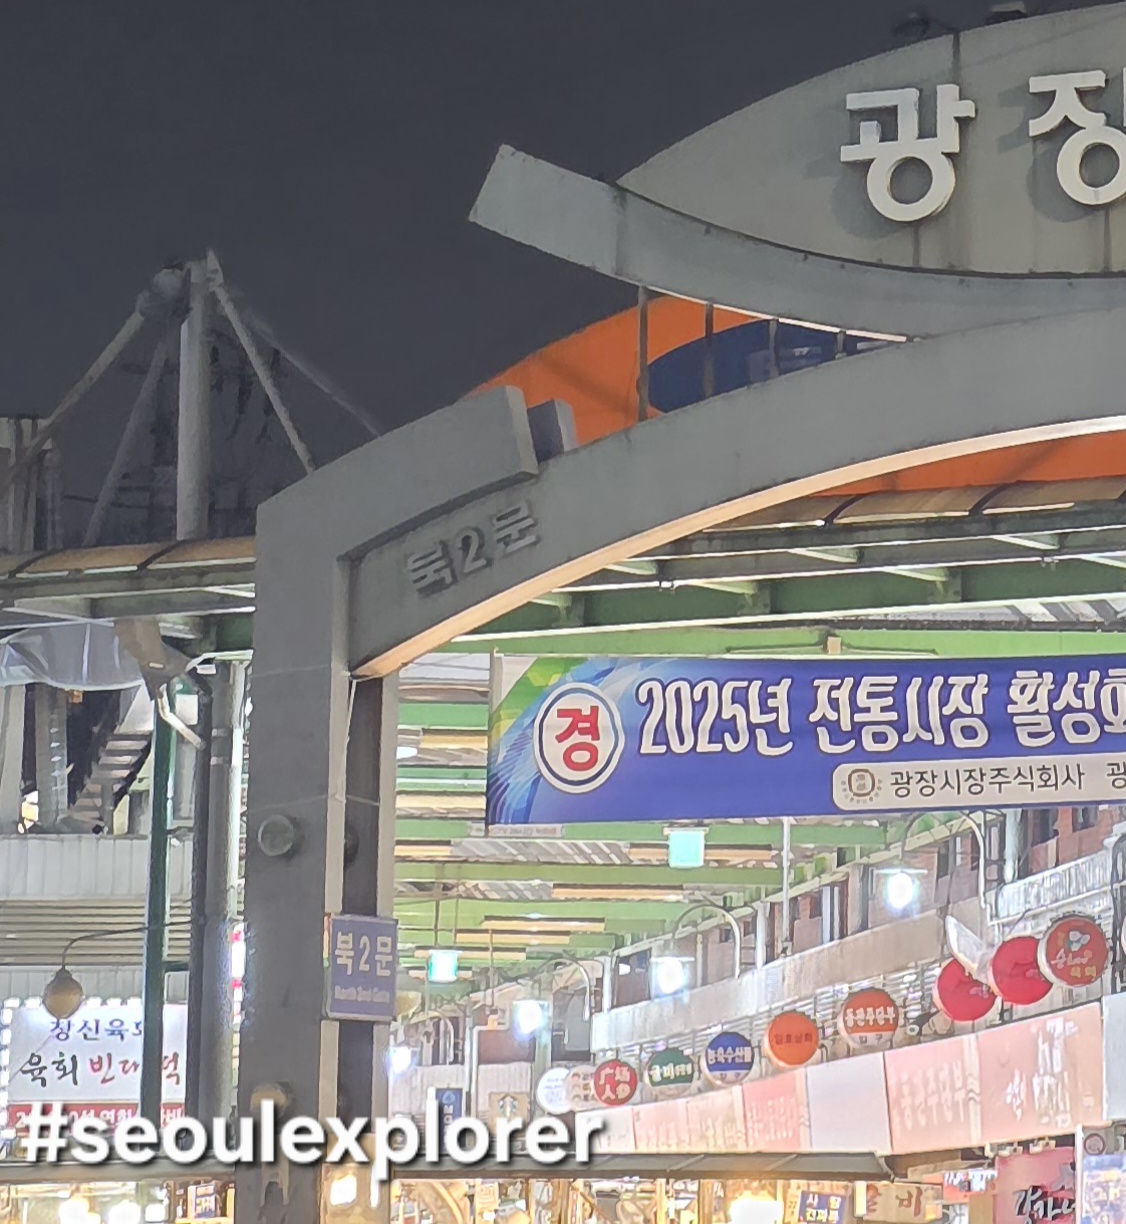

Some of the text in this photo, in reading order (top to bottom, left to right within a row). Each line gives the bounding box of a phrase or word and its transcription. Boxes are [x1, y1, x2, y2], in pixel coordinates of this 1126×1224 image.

[407, 500, 538, 589] 북2문
[553, 706, 599, 772] 경
[637, 676, 793, 757] 2025년
[807, 671, 989, 754] 전통시장
[889, 763, 1086, 798] 광장시장주식회사
[335, 931, 393, 977] 북2문
[21, 1051, 79, 1087] 육회
